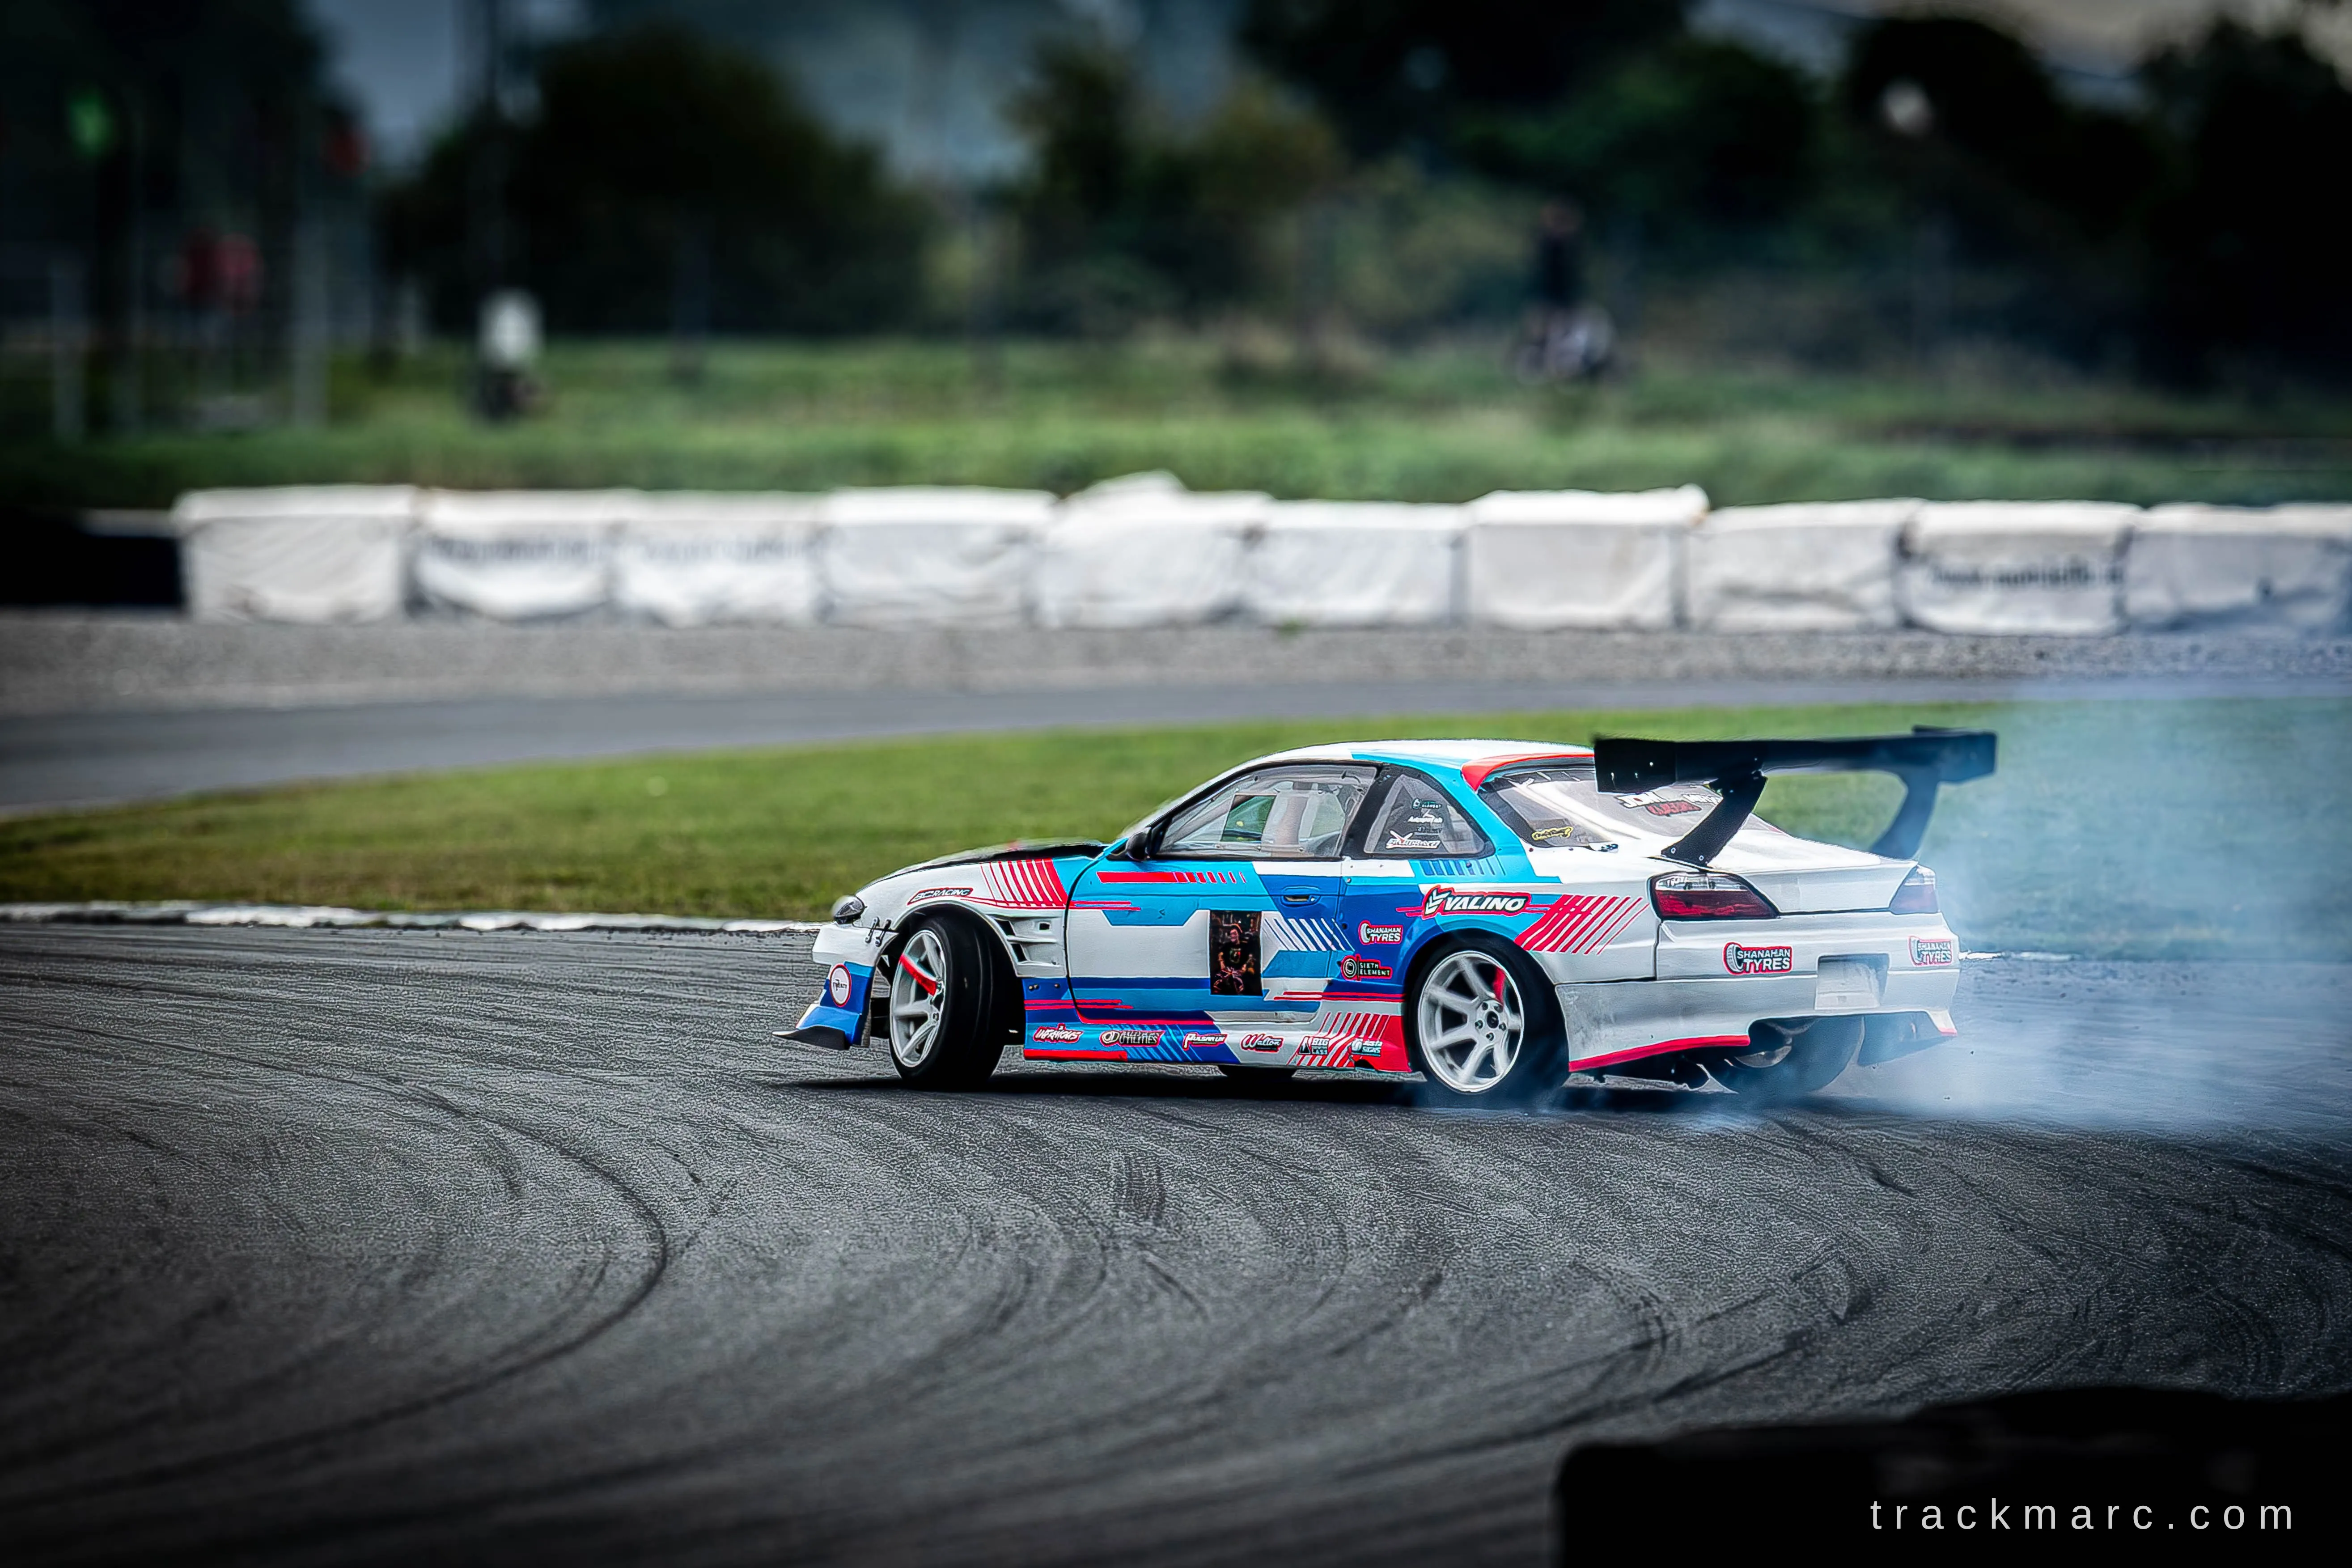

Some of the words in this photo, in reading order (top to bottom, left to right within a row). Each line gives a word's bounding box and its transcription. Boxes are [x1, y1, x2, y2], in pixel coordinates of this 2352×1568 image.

[1444, 896, 1526, 911] VALINO
[1370, 933, 1401, 942] TYRES
[1737, 949, 1790, 959] SHANAHAN
[1921, 950, 1951, 963] TYRES
[1743, 958, 1790, 971] TYRES
[1242, 1034, 1282, 1047] Walton
[1312, 1038, 1329, 1046] BIG
